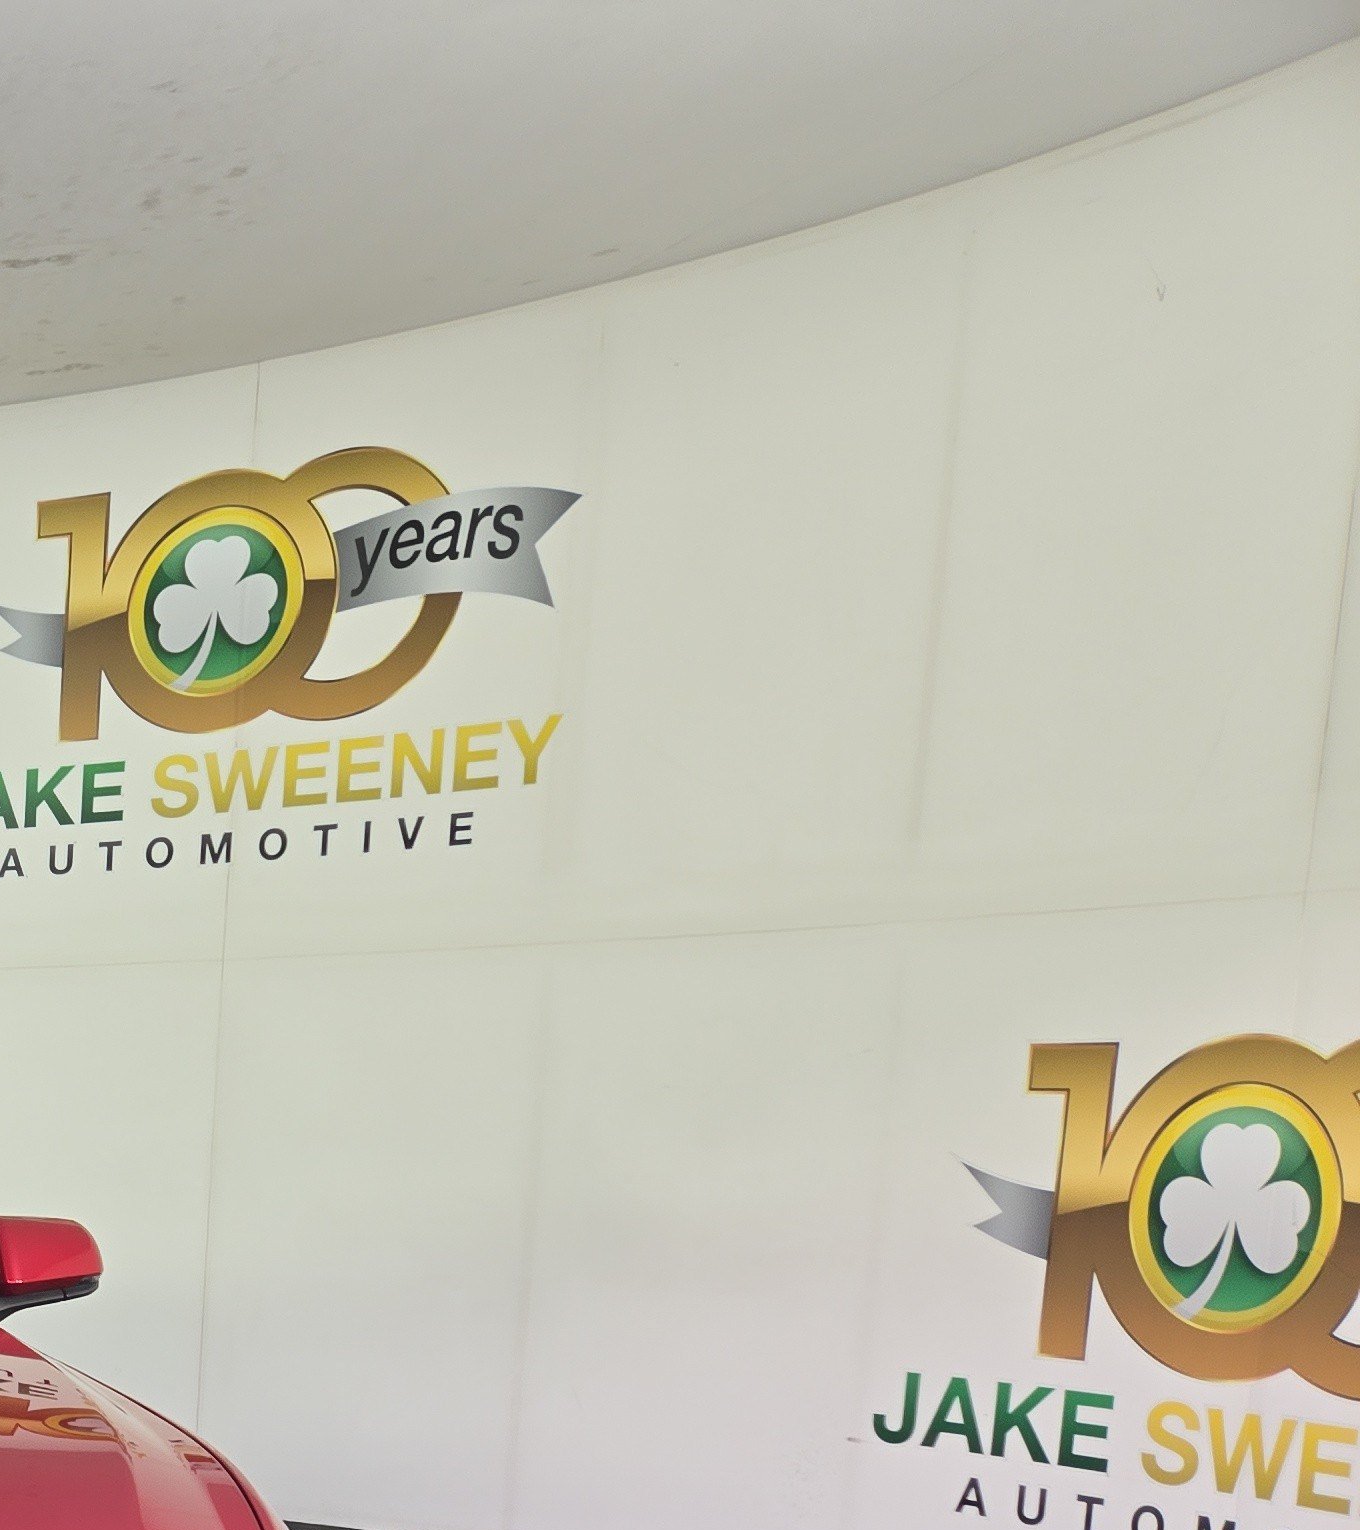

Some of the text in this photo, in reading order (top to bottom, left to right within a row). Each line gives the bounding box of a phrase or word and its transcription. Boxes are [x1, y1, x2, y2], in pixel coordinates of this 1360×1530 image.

[37, 446, 463, 742] 100
[350, 503, 524, 598] years
[151, 714, 563, 819] SWEENEY
[1028, 1033, 1360, 1401] 10
[872, 1371, 1360, 1516] JAKE SWE
